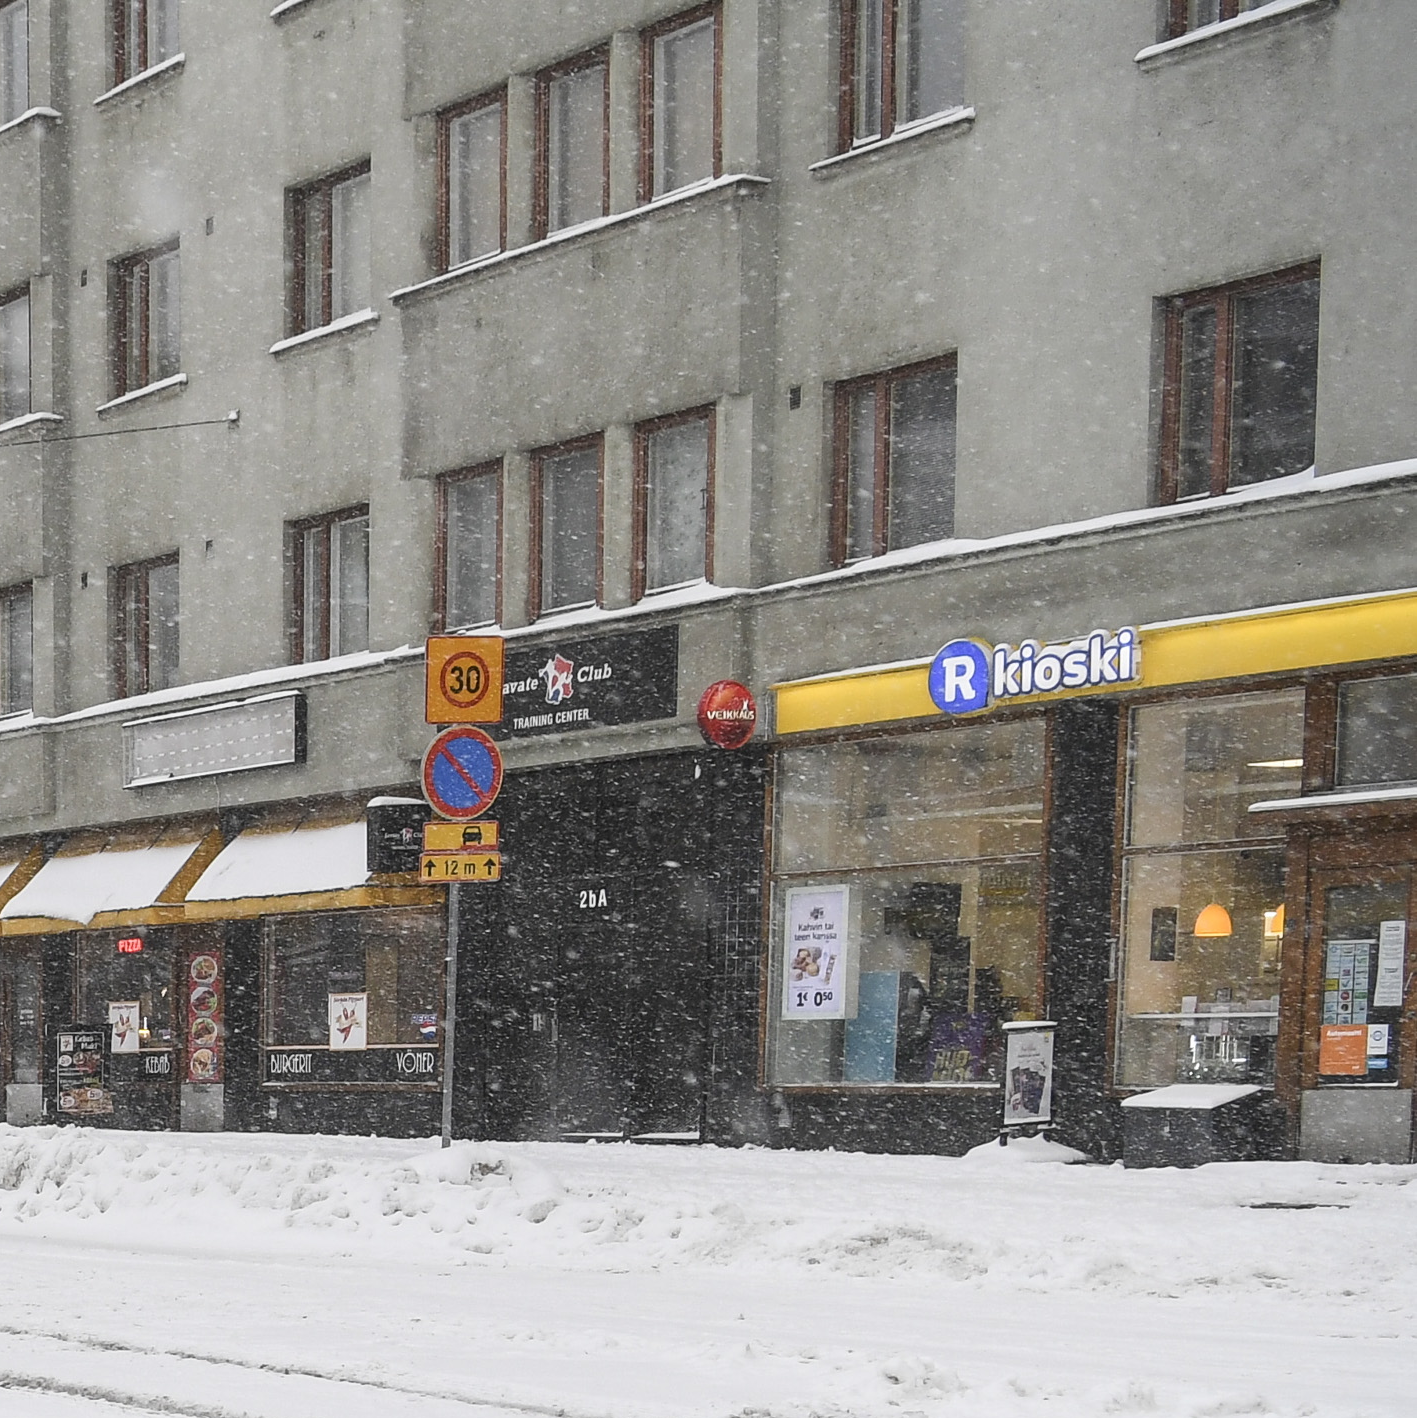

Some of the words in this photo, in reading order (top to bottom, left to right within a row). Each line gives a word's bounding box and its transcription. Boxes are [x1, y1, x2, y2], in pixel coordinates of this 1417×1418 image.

[942, 656, 976, 703] R
[992, 628, 1133, 698] kioski
[449, 664, 481, 695] 30
[503, 677, 538, 695] avate
[577, 665, 613, 683] Club
[513, 716, 553, 731] TRAINING
[555, 707, 590, 725] CENTER
[707, 710, 755, 720] VEIKKAUS
[444, 860, 458, 877] 12
[464, 863, 476, 876] m
[579, 888, 608, 908] 2bA
[270, 1053, 312, 1074] BURGERIT
